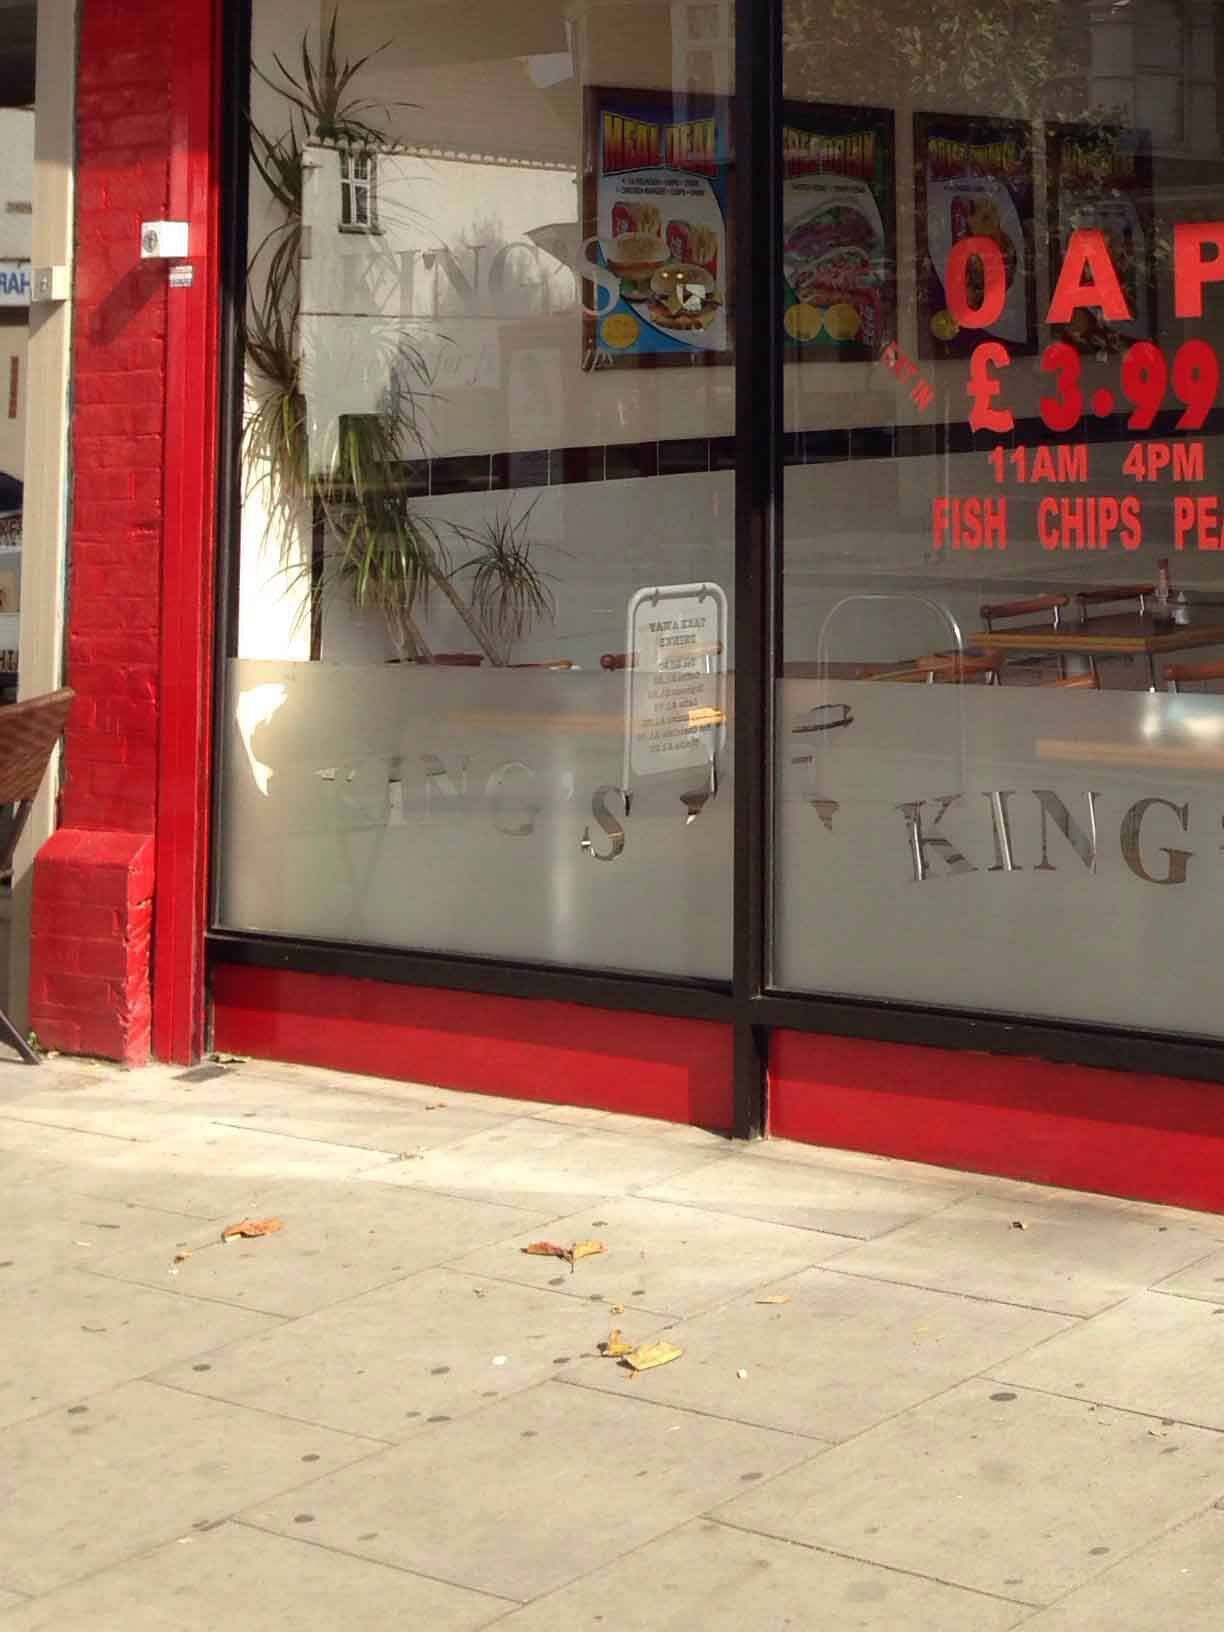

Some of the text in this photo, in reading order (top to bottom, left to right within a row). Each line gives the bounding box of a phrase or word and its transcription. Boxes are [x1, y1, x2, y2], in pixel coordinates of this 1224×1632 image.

[989, 441, 1206, 483] 11AM 4PM
[932, 495, 1009, 550] FISH
[1037, 495, 1144, 550] CHIPS
